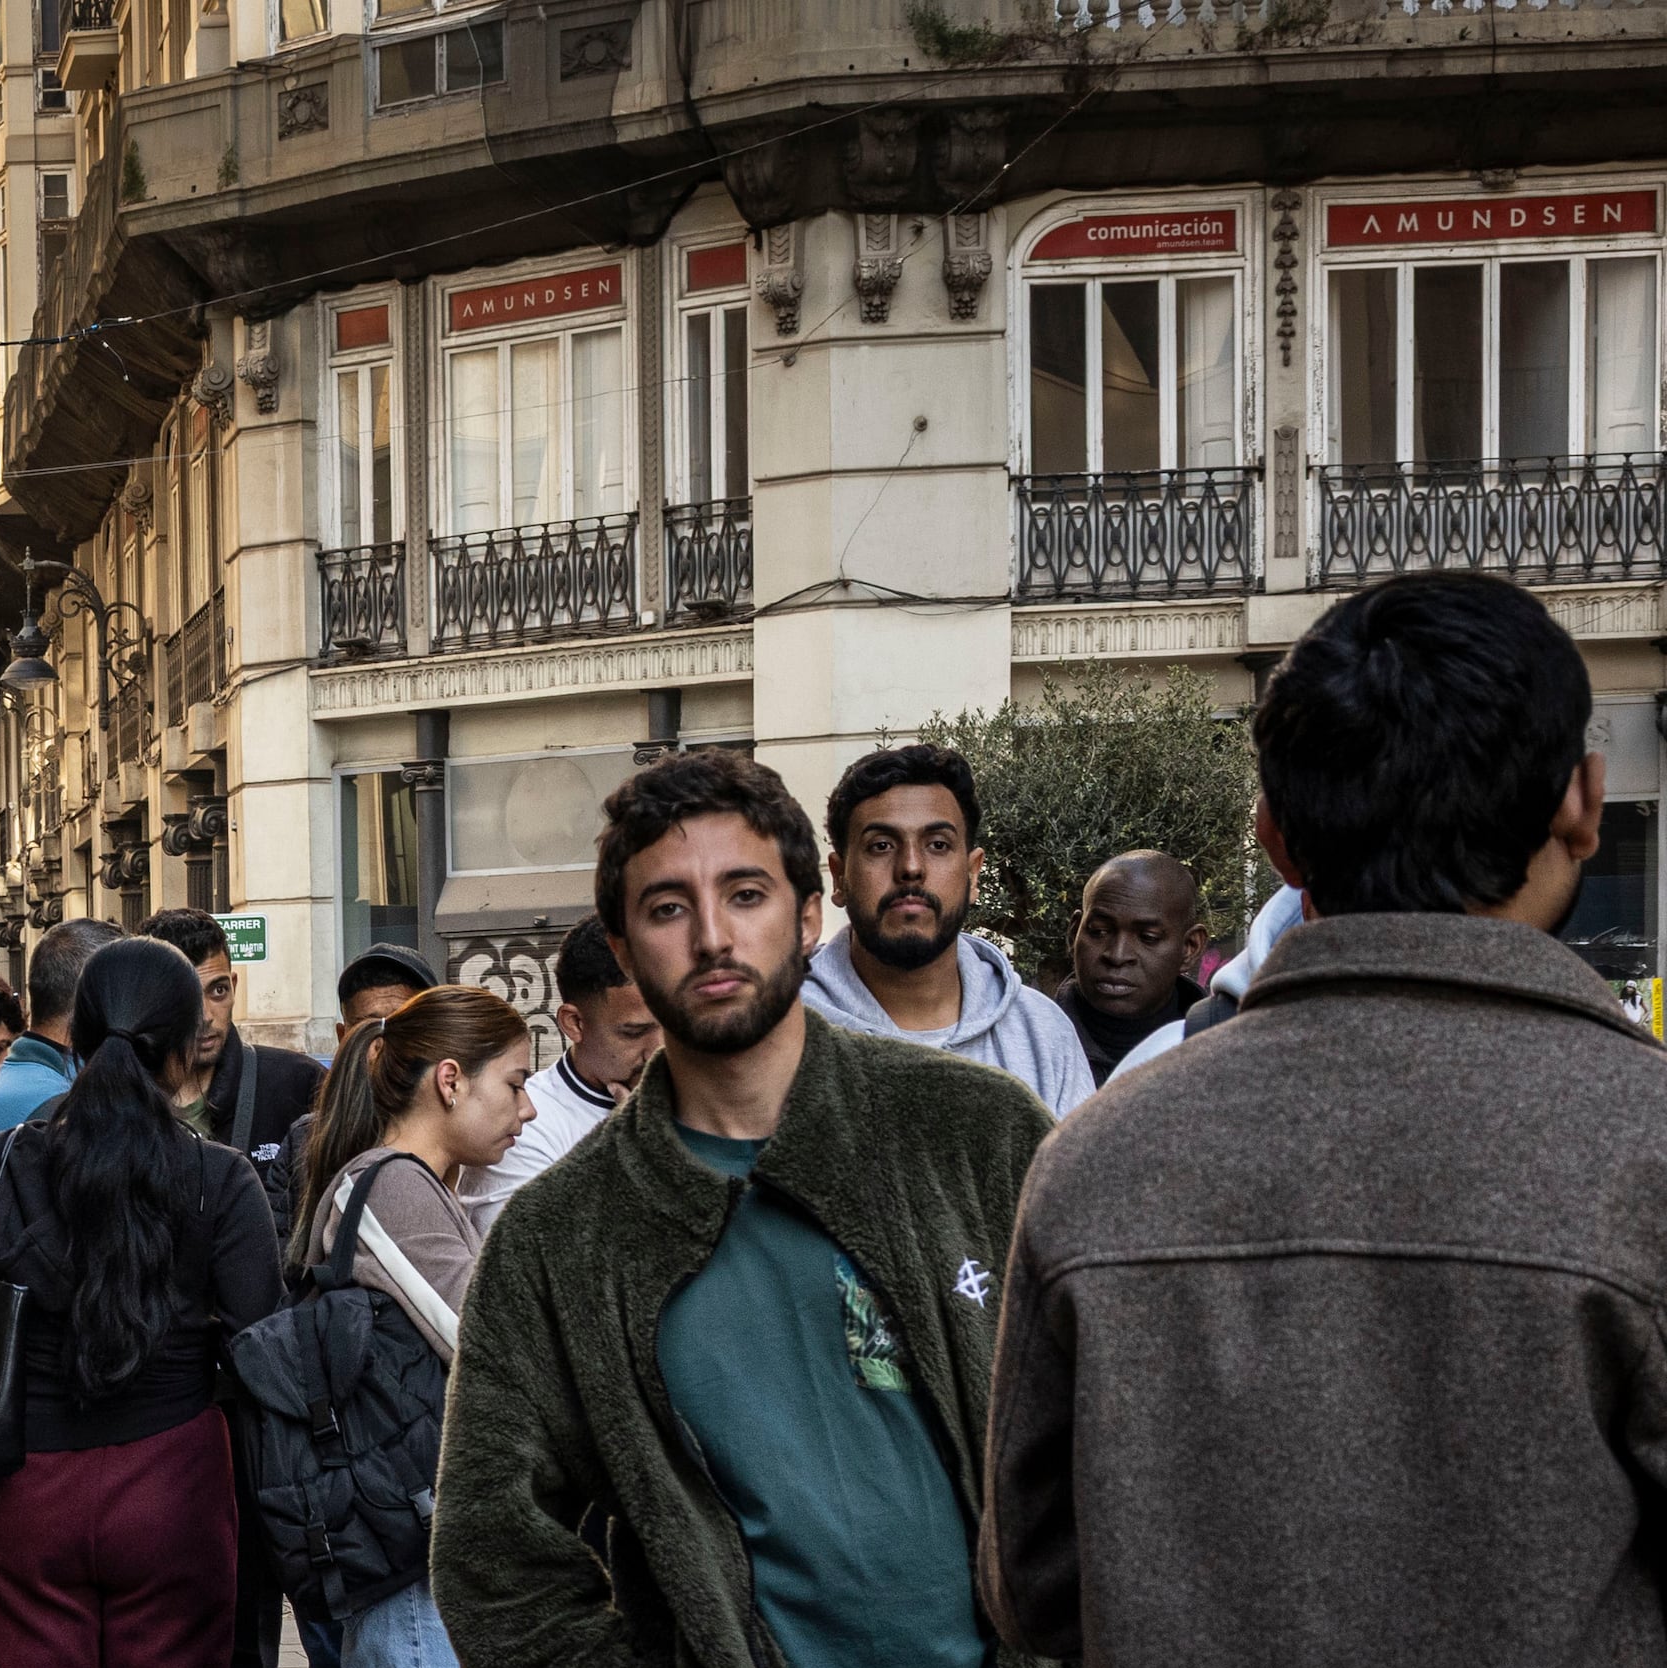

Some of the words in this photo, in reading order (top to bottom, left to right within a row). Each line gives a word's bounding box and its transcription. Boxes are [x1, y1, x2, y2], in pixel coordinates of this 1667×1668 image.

[1087, 216, 1224, 241] comunicación
[1362, 203, 1623, 235] AMUNDSEN
[1156, 238, 1225, 249] amundsen.team
[462, 279, 611, 318] AMUNDSEN
